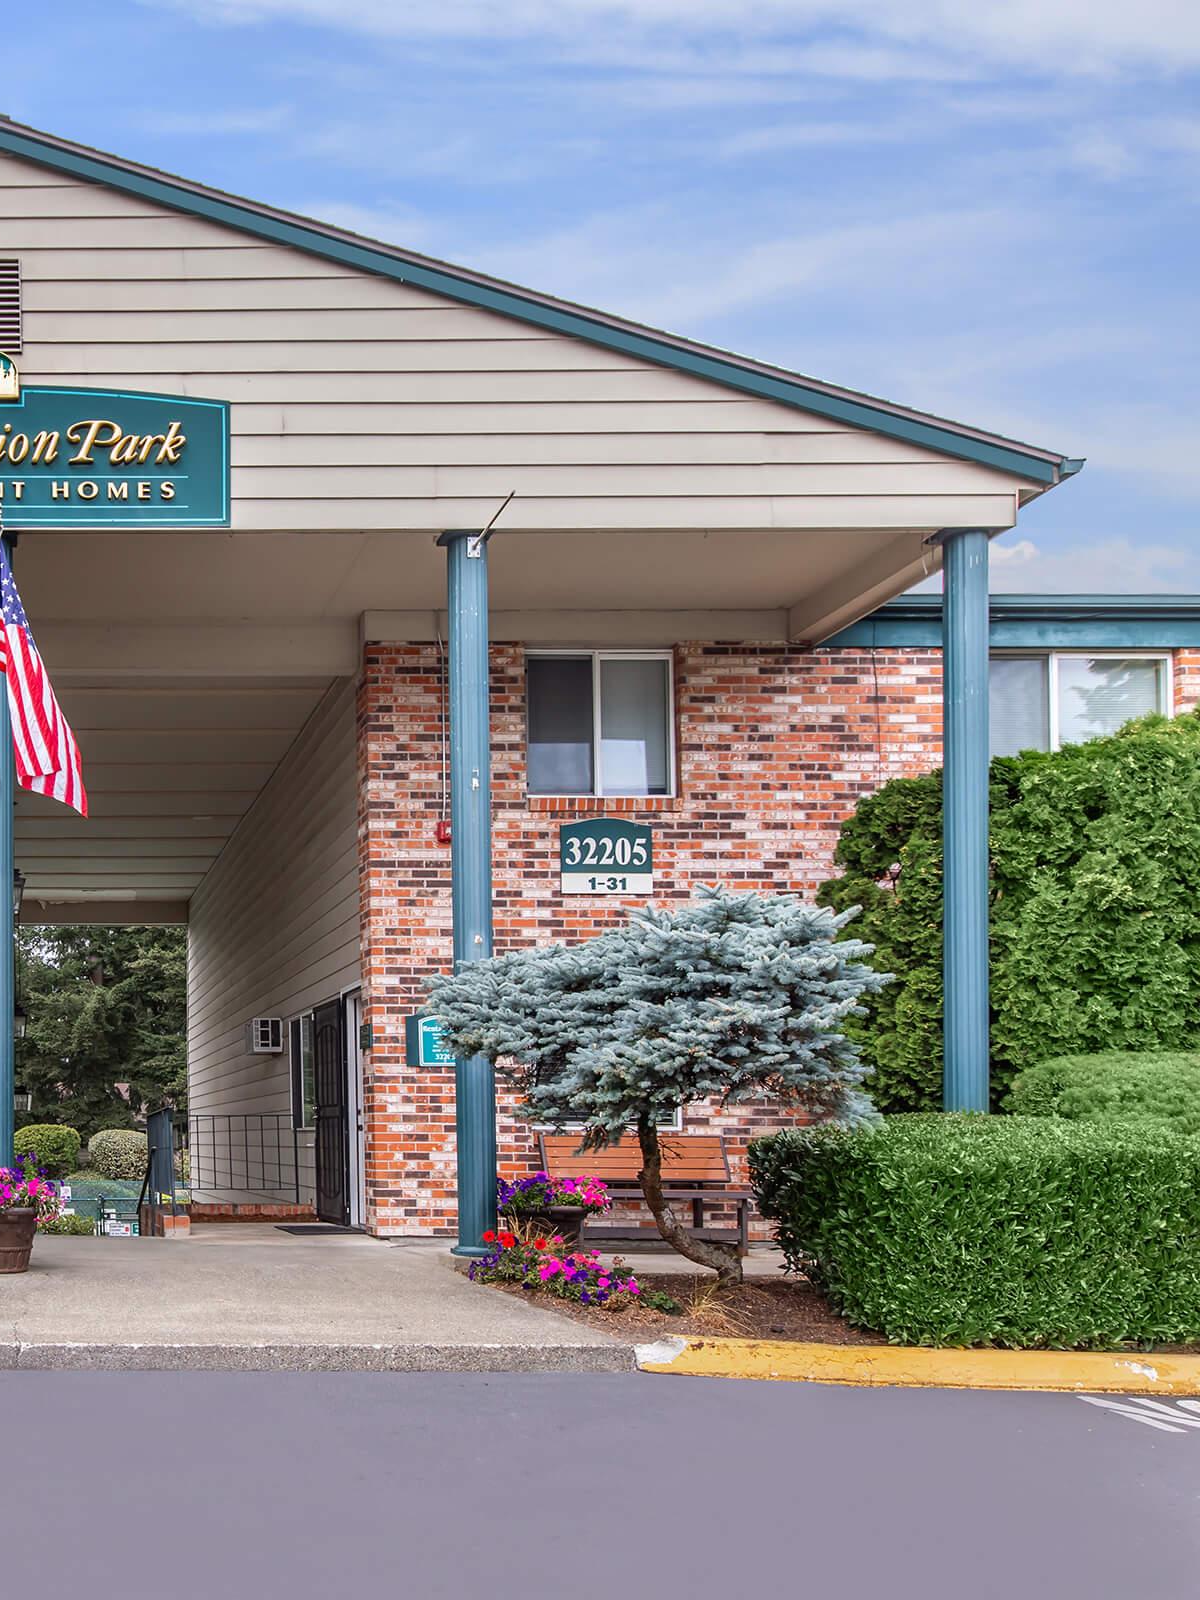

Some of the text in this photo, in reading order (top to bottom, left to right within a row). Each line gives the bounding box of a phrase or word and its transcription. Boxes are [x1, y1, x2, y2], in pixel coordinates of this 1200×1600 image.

[66, 420, 186, 465] Park
[51, 480, 177, 500] HOMES
[565, 837, 647, 866] 32205
[588, 877, 627, 891] 1-31
